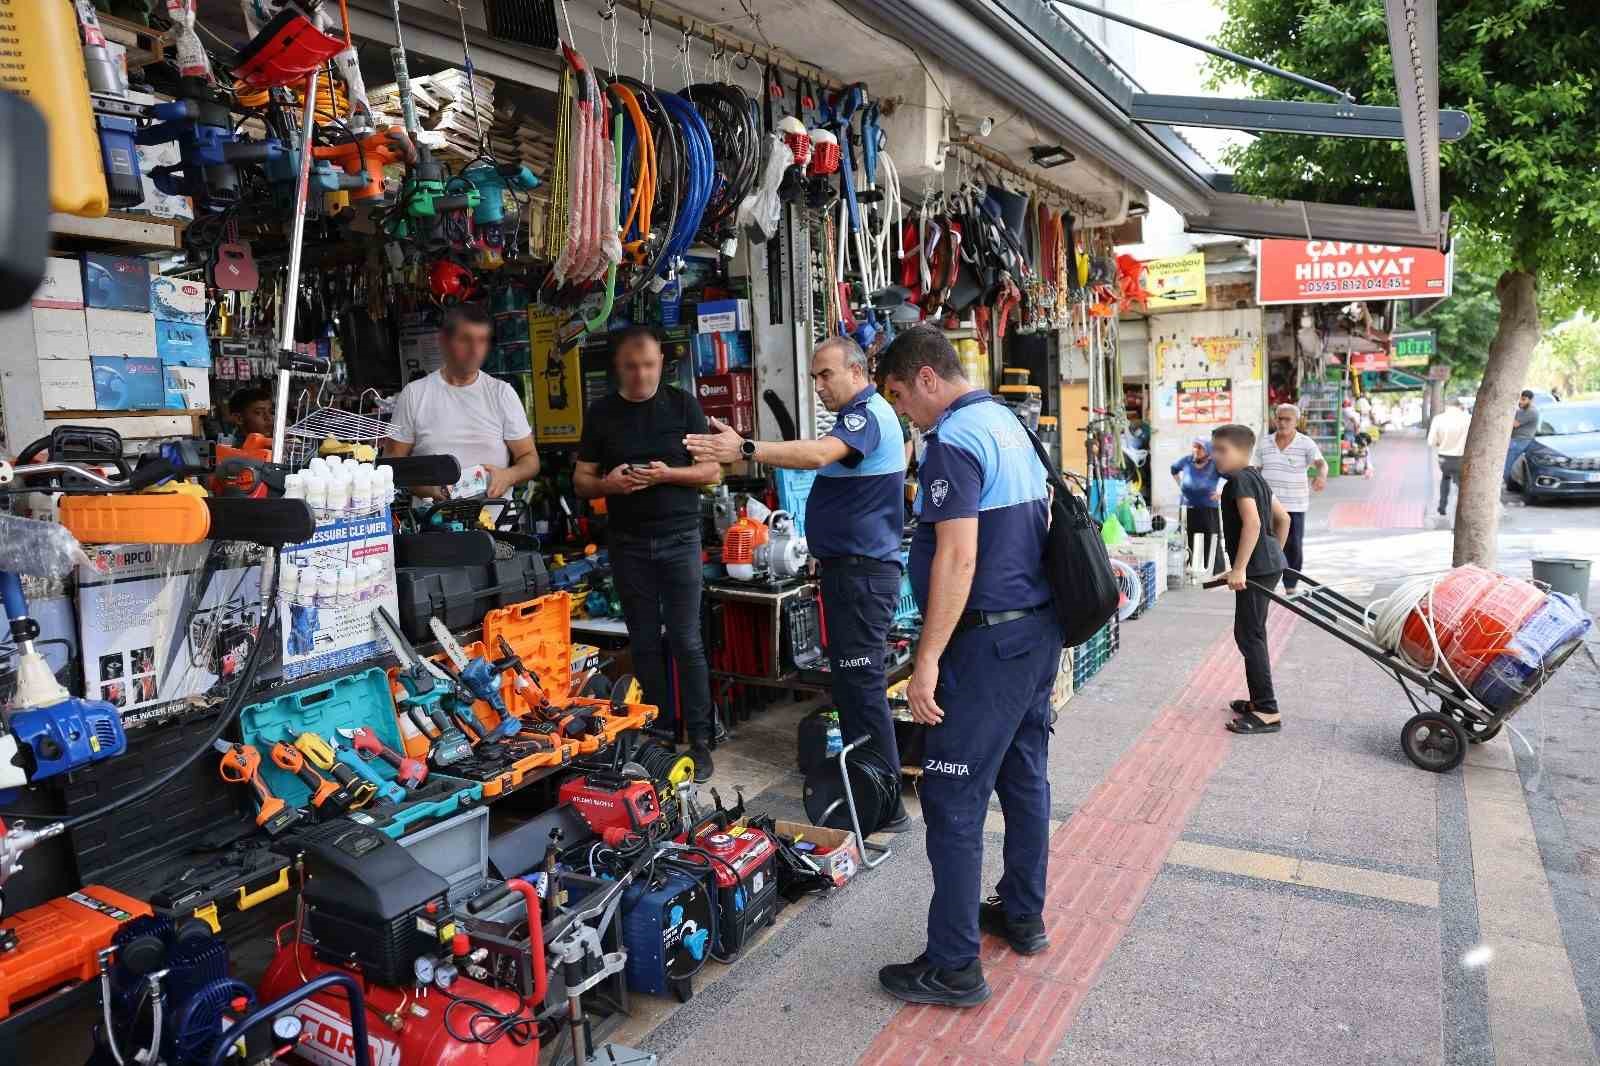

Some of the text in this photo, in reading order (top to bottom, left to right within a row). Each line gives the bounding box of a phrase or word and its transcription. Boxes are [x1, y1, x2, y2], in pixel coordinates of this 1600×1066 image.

[1296, 257, 1415, 280] HİRDAVAT
[1308, 278, 1402, 292] 0545 812 04 45
[305, 521, 387, 544] ESSURE CLEANER
[839, 656, 872, 668] ZABITA
[167, 703, 187, 715] PUM
[925, 759, 970, 776] ZABITA
